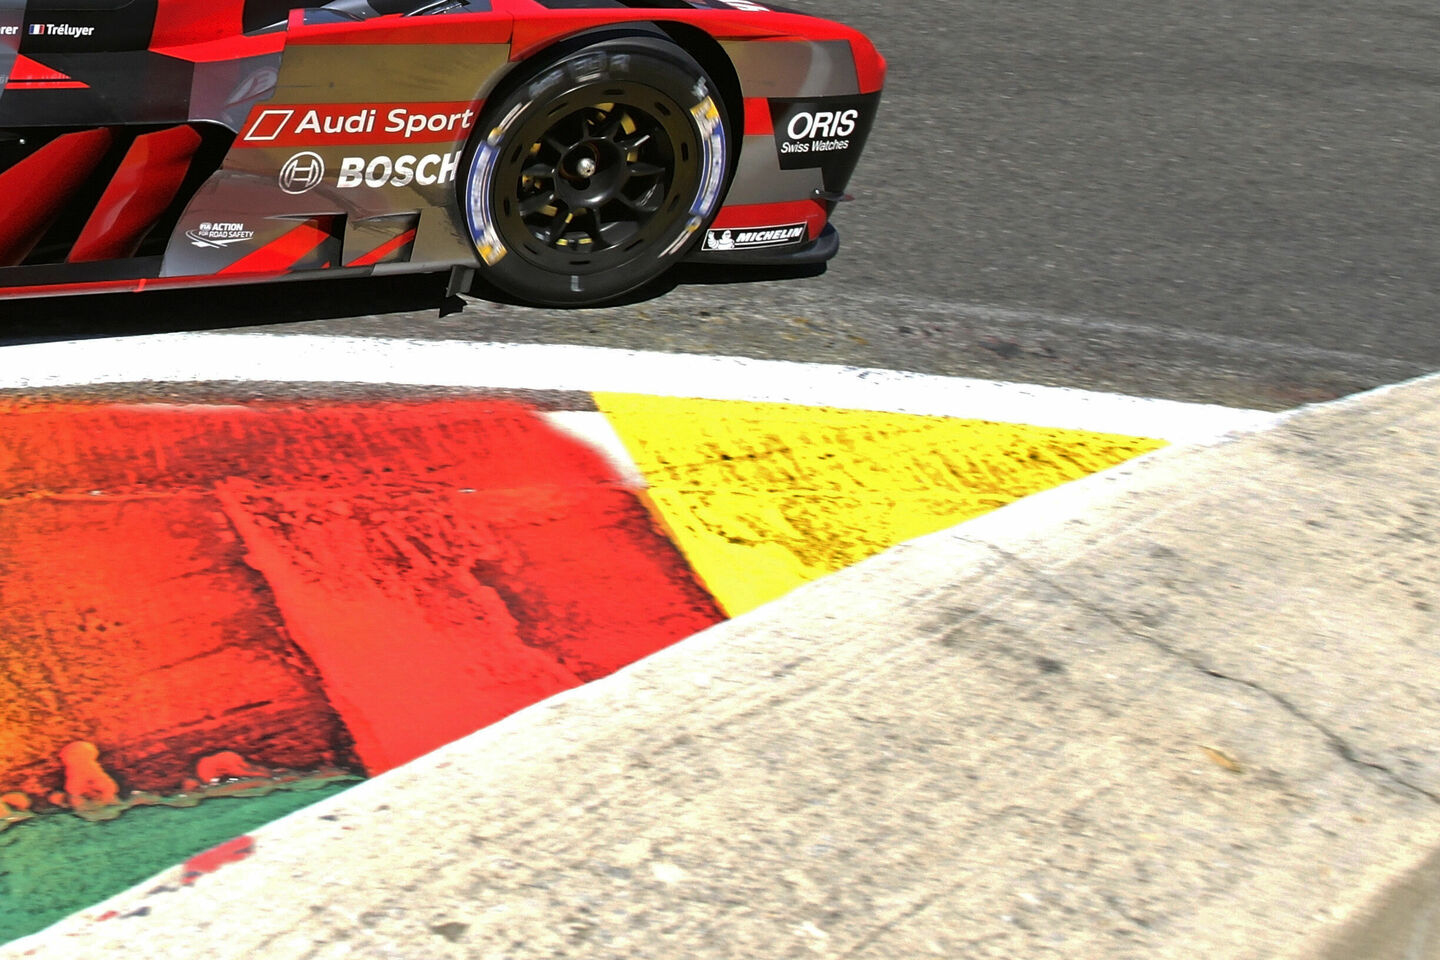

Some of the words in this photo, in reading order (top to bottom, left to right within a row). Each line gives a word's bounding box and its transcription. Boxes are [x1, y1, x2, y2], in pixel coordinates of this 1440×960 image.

[46, 23, 95, 37] Tréluyer
[294, 109, 376, 135] Audi
[384, 108, 475, 138] Sport
[787, 109, 858, 140] ORIS
[780, 141, 809, 154] Swiss
[811, 139, 849, 152] Watches
[336, 150, 462, 189] BOSCH
[212, 222, 244, 231] ACTION
[736, 227, 803, 243] MICHELIN
